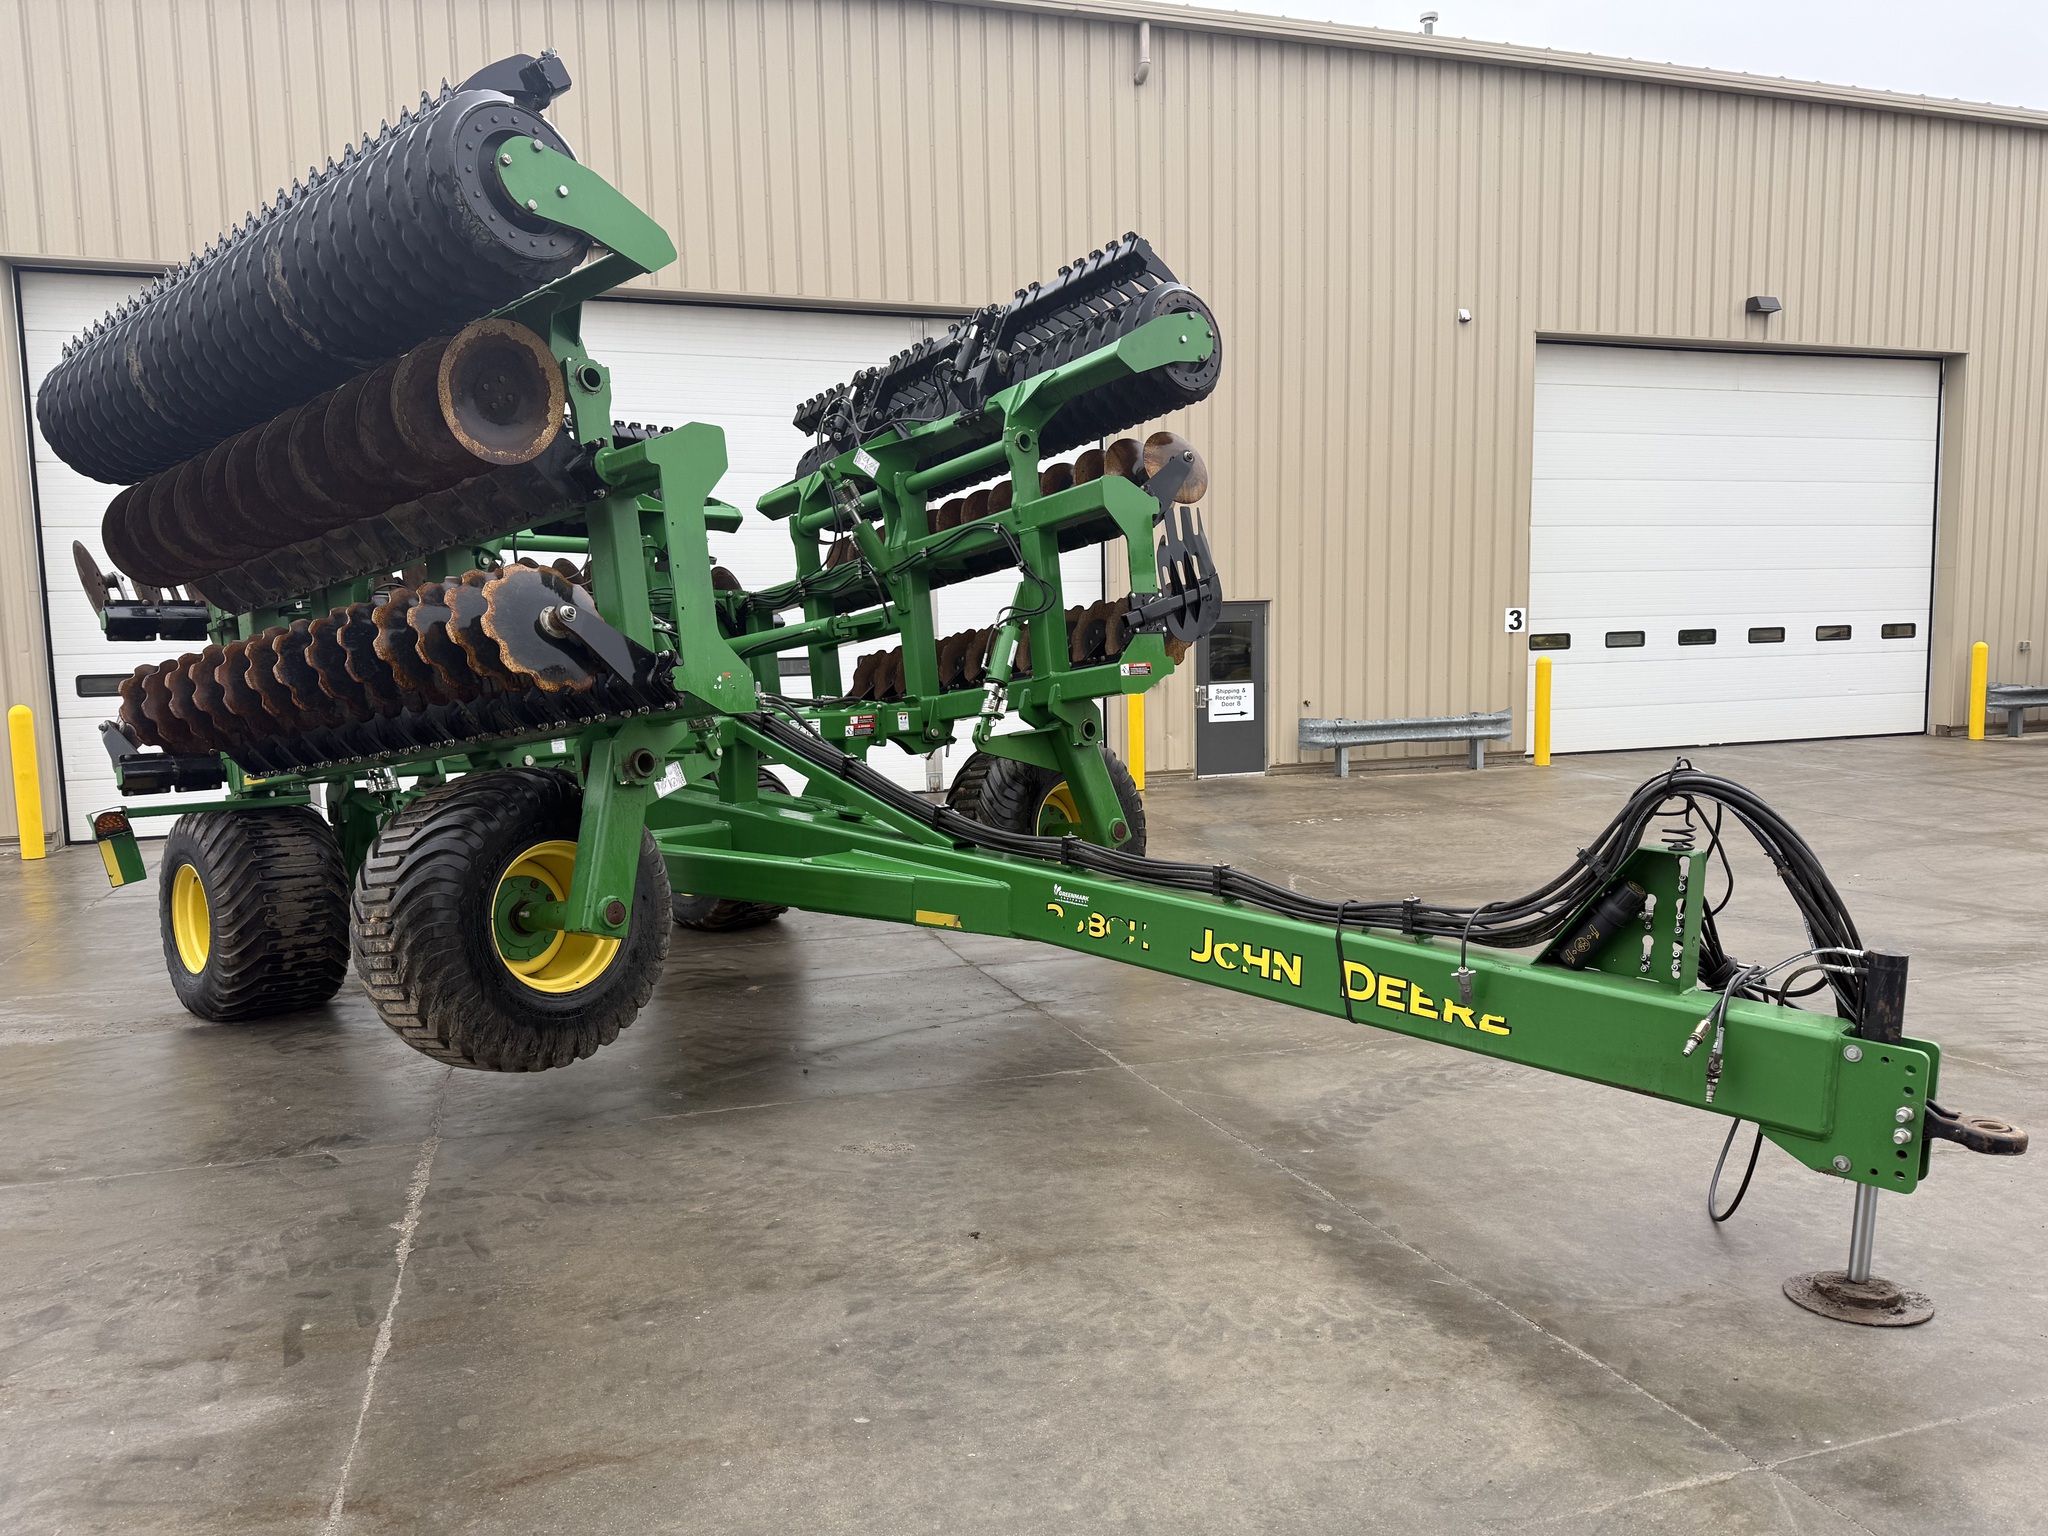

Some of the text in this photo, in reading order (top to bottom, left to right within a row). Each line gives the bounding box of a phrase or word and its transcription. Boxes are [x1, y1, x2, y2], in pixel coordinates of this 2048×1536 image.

[1508, 609, 1523, 631] 3
[1190, 927, 1512, 1036] JOHN DEERE
